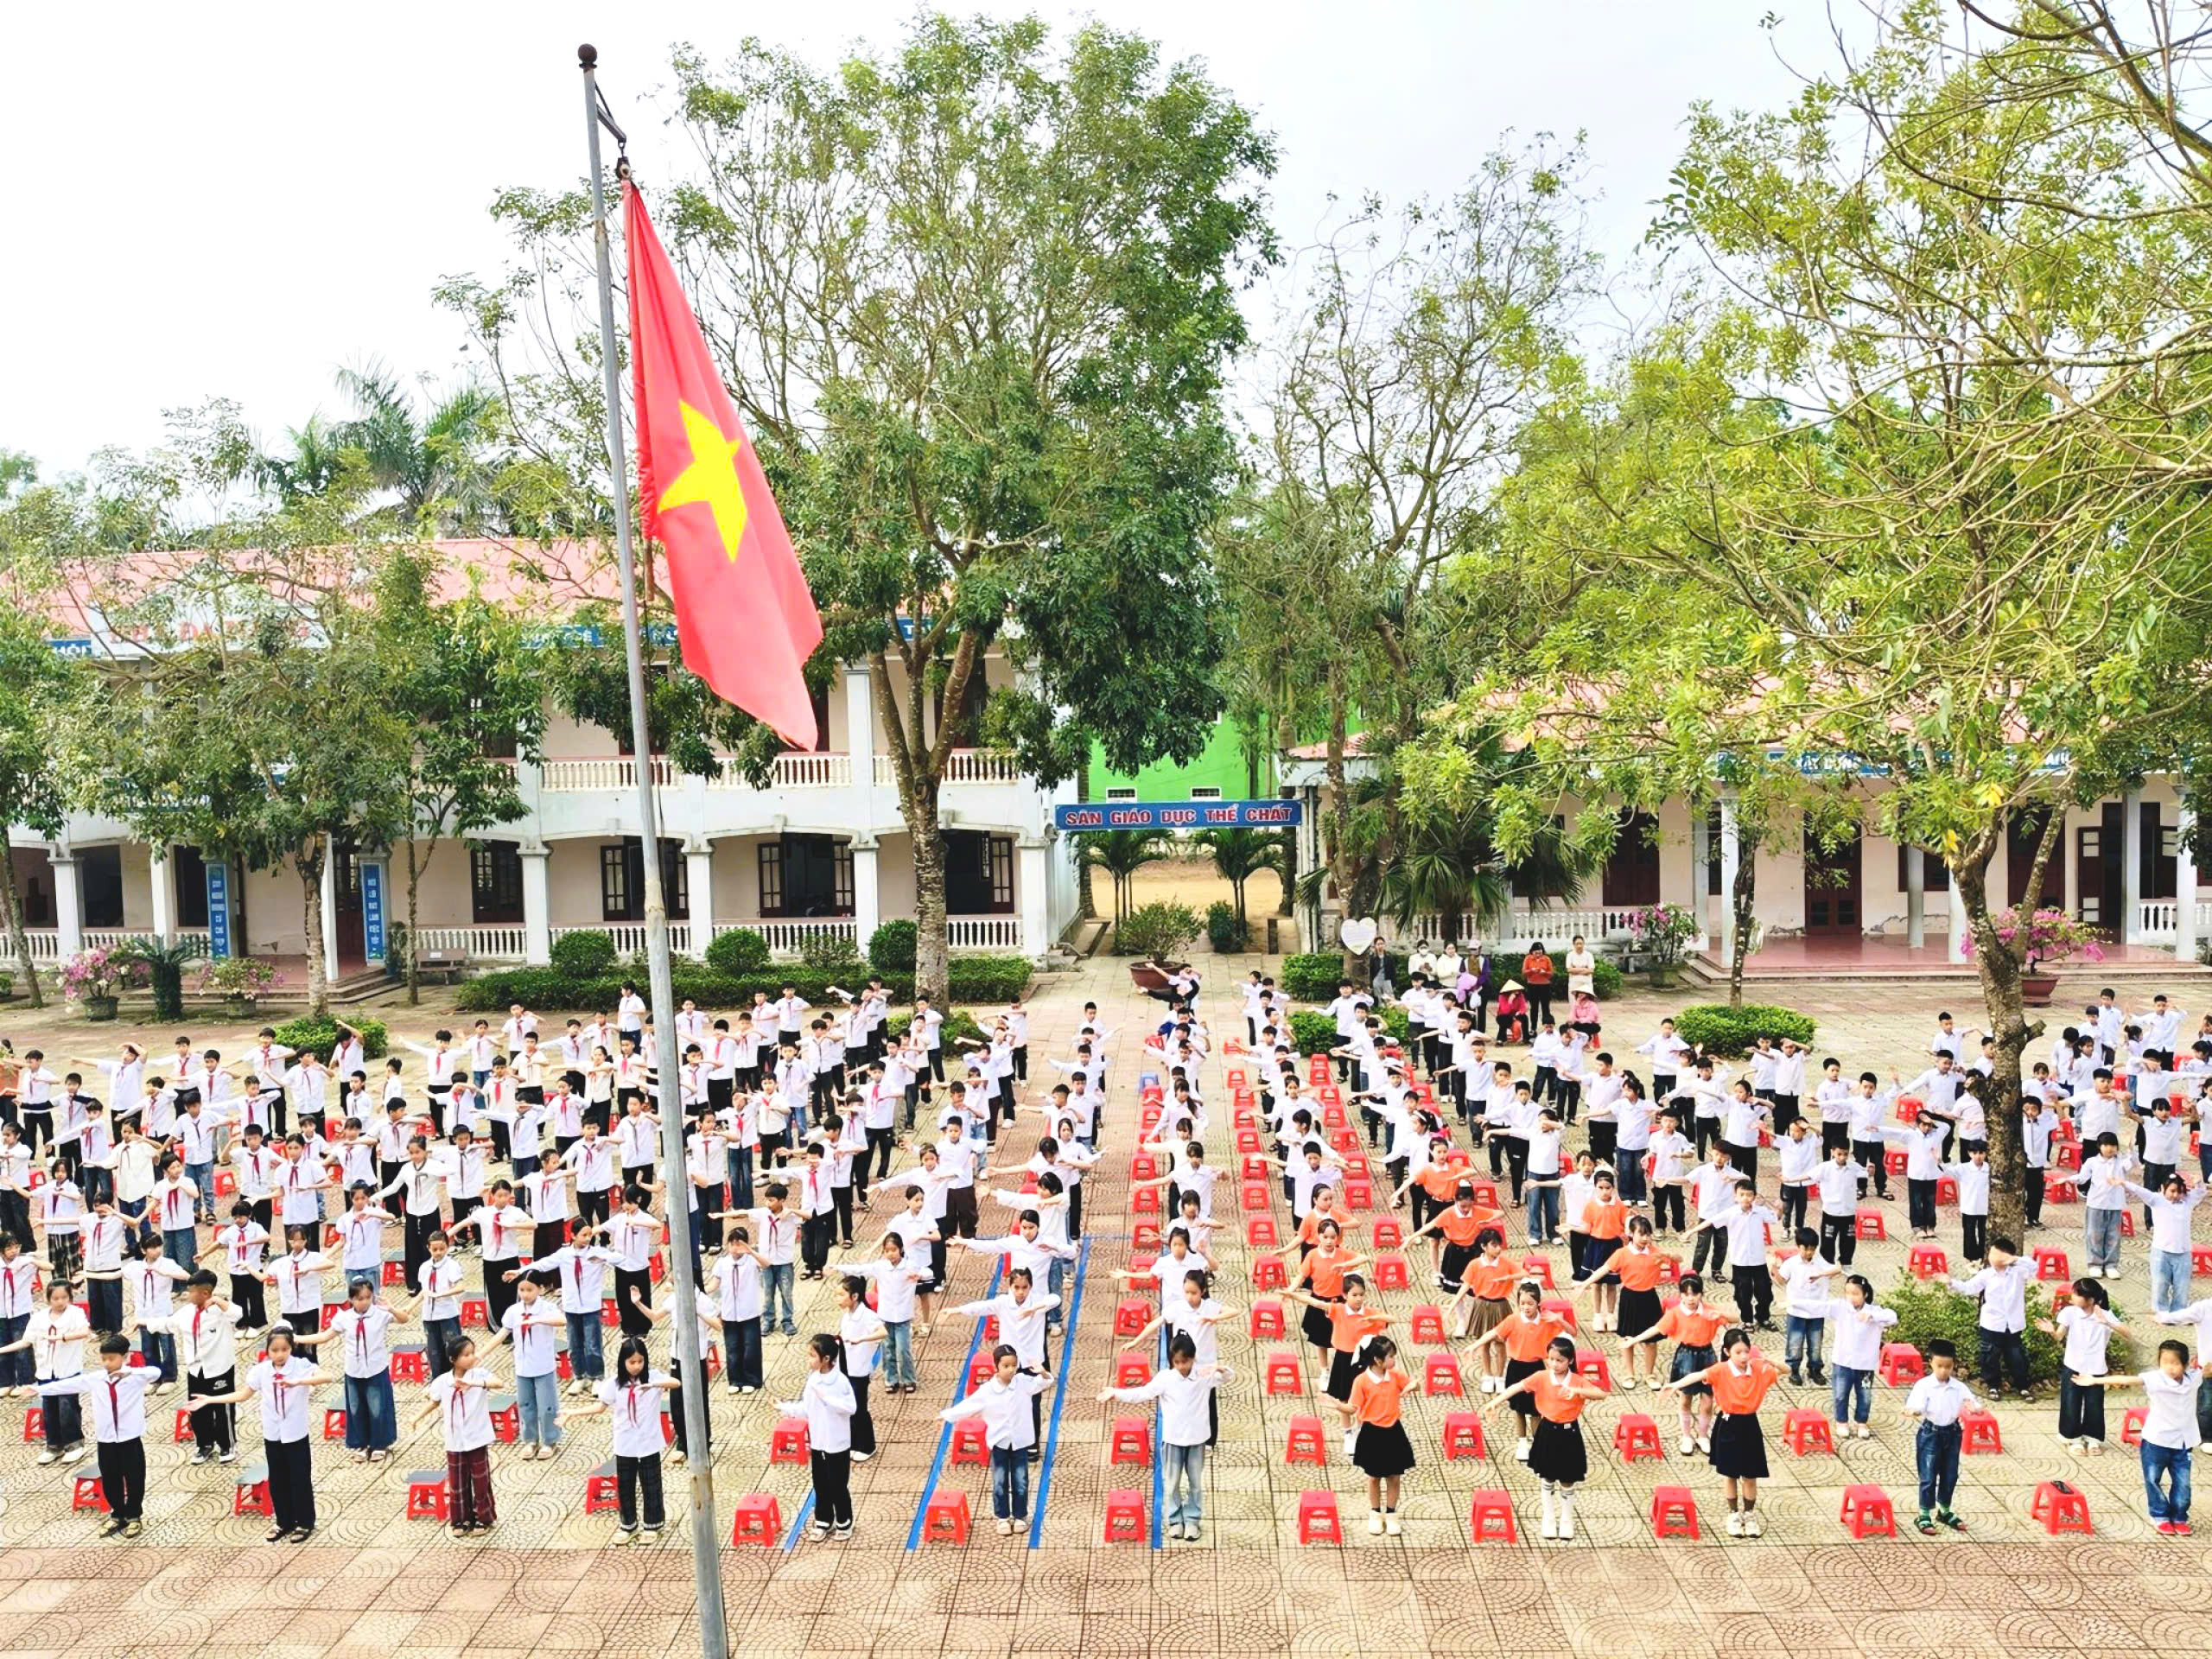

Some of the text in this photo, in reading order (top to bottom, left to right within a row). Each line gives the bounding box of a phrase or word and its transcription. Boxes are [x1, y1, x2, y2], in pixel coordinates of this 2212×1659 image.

[1109, 808, 1153, 824] GIÁO
[1160, 809, 1197, 827] DỤC
[1245, 803, 1293, 822] CHẤT
